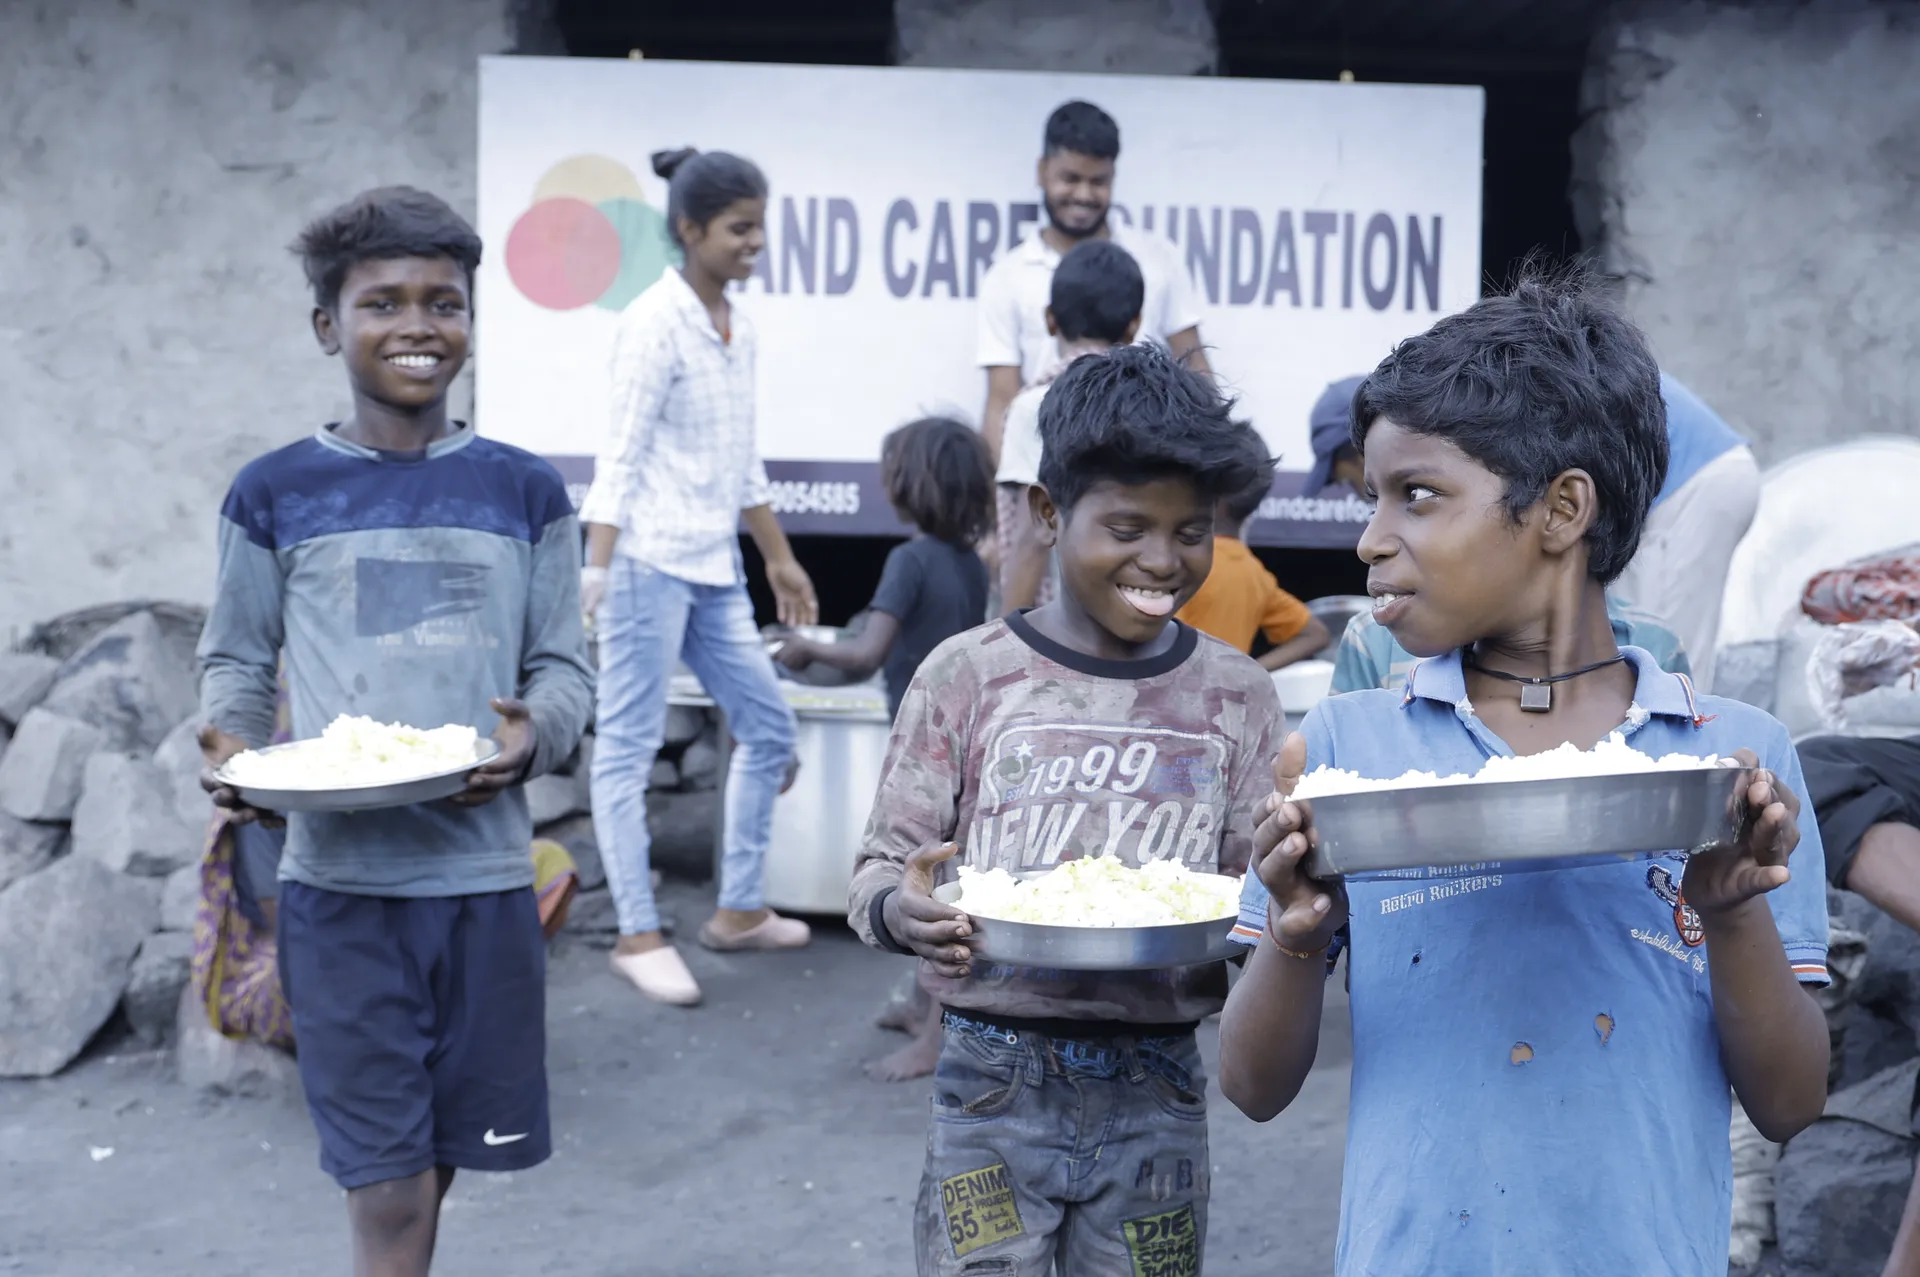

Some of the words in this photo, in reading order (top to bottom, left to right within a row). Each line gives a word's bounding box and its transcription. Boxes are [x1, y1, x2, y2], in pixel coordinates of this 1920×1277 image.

[1110, 203, 1442, 313] NDATION
[1028, 741, 1157, 795] 1999
[964, 801, 1089, 870] NEW
[1101, 799, 1221, 865] YOR
[1631, 928, 1692, 963] established
[943, 1167, 1008, 1207] DENIM
[975, 1191, 1012, 1211] PROJECT
[949, 1208, 980, 1245] 55
[1132, 1206, 1190, 1244] DIE
